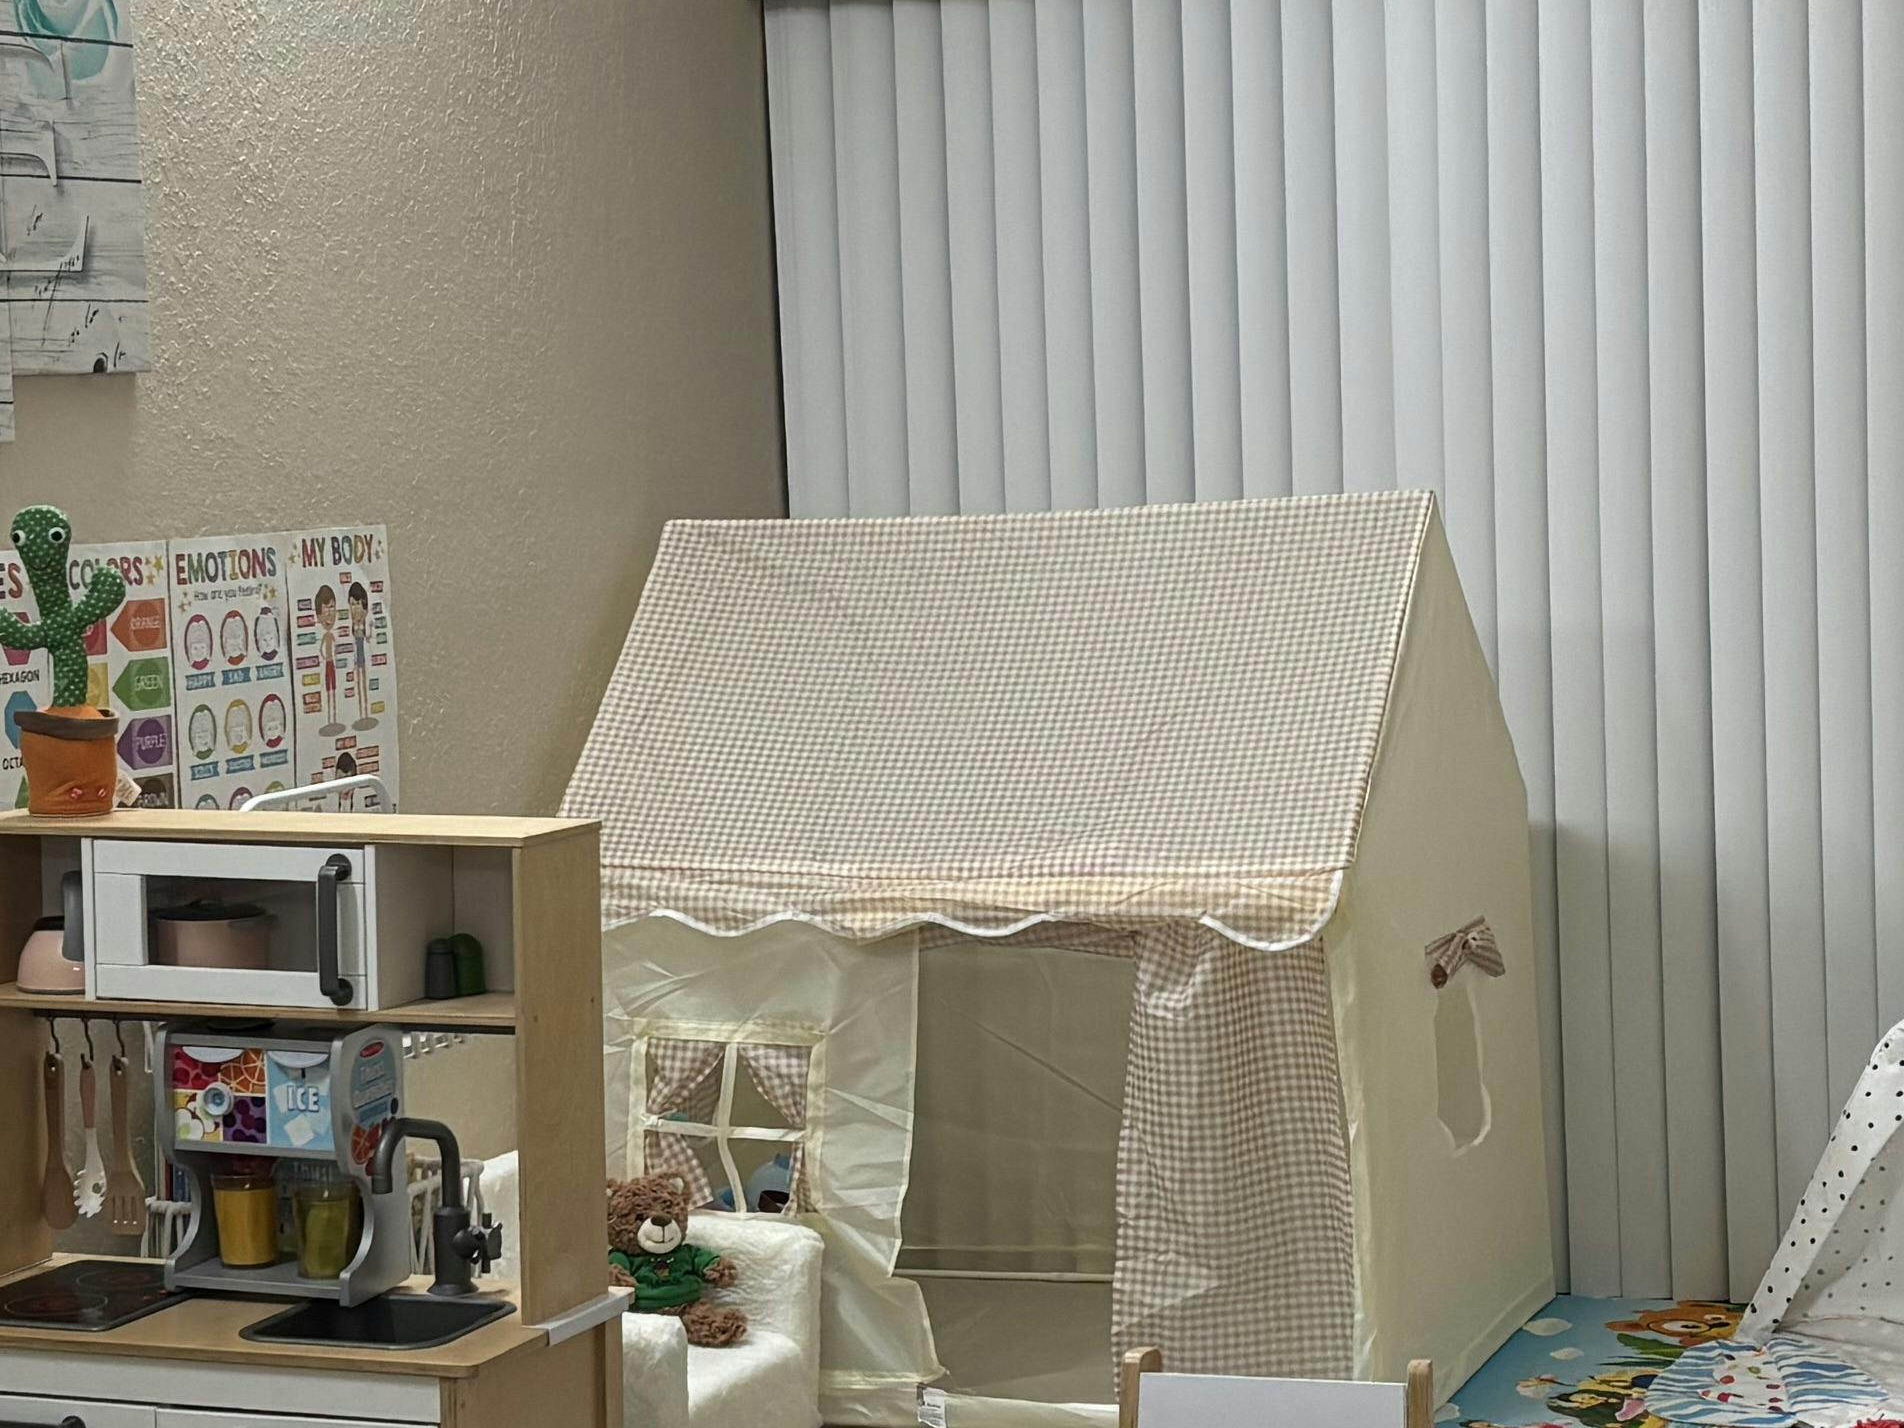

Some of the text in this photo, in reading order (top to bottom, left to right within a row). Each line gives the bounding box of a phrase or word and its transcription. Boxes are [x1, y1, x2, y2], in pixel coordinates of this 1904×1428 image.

[175, 548, 276, 585] EMOTIONS
[302, 534, 373, 567] MY BODY
[287, 1085, 320, 1113] ICE
